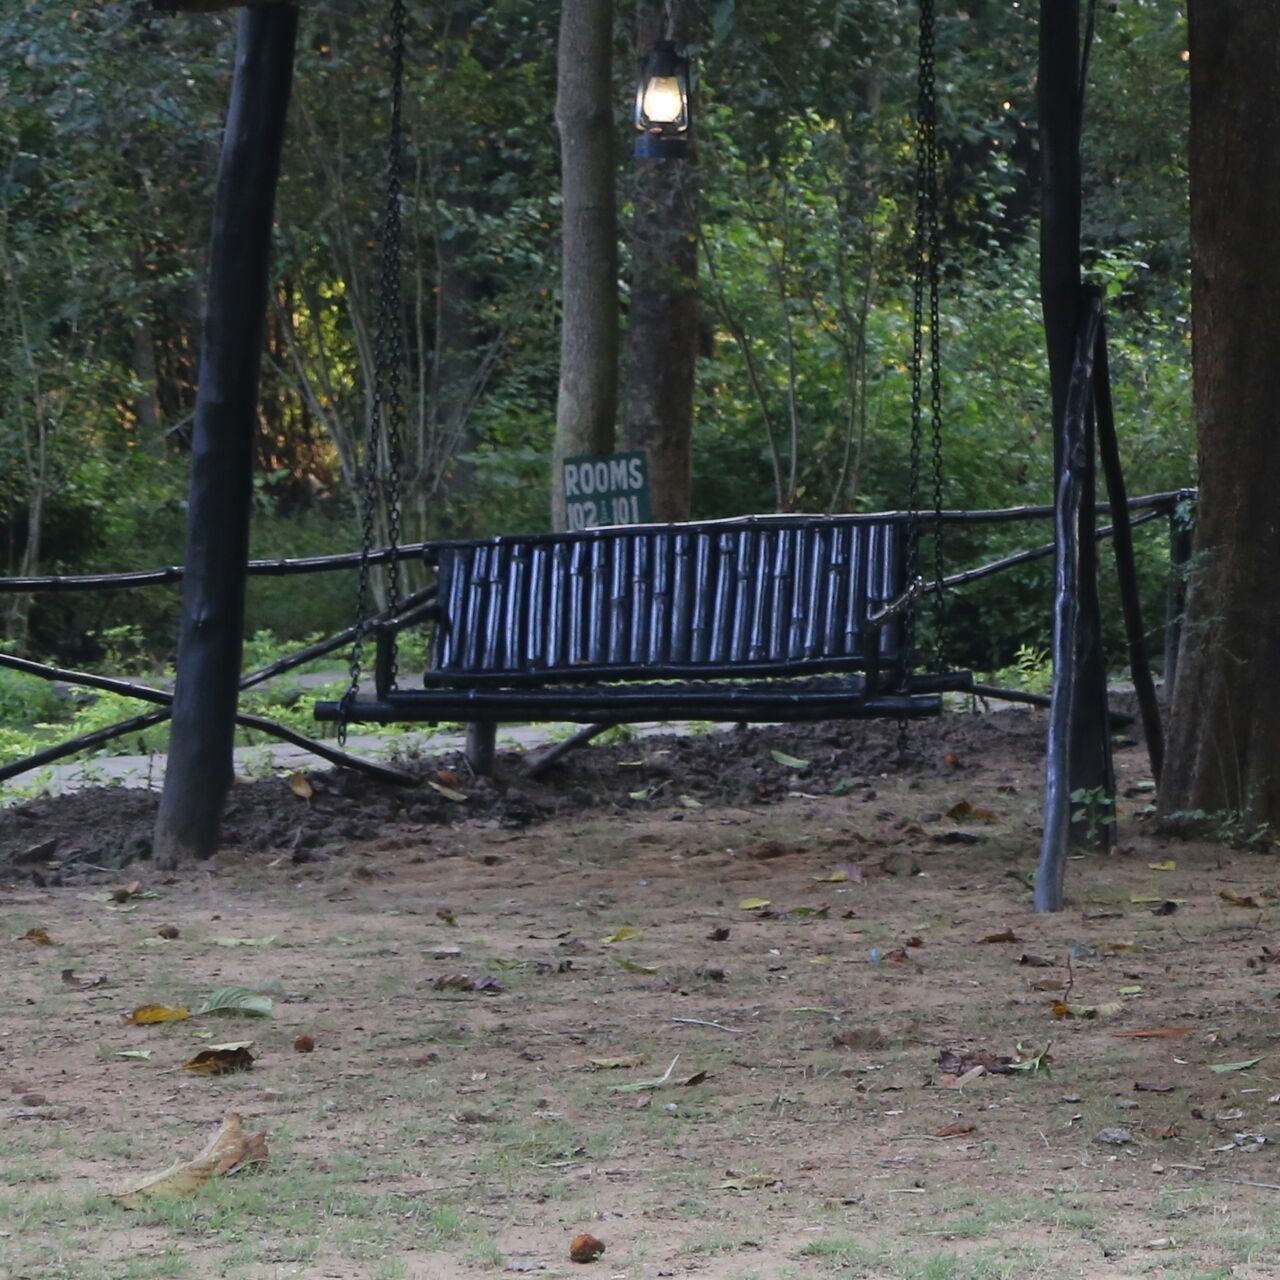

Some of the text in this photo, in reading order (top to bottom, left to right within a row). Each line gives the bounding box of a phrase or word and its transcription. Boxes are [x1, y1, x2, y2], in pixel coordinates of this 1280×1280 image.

[564, 458, 644, 496] ROOMS
[567, 495, 639, 531] 102 101
